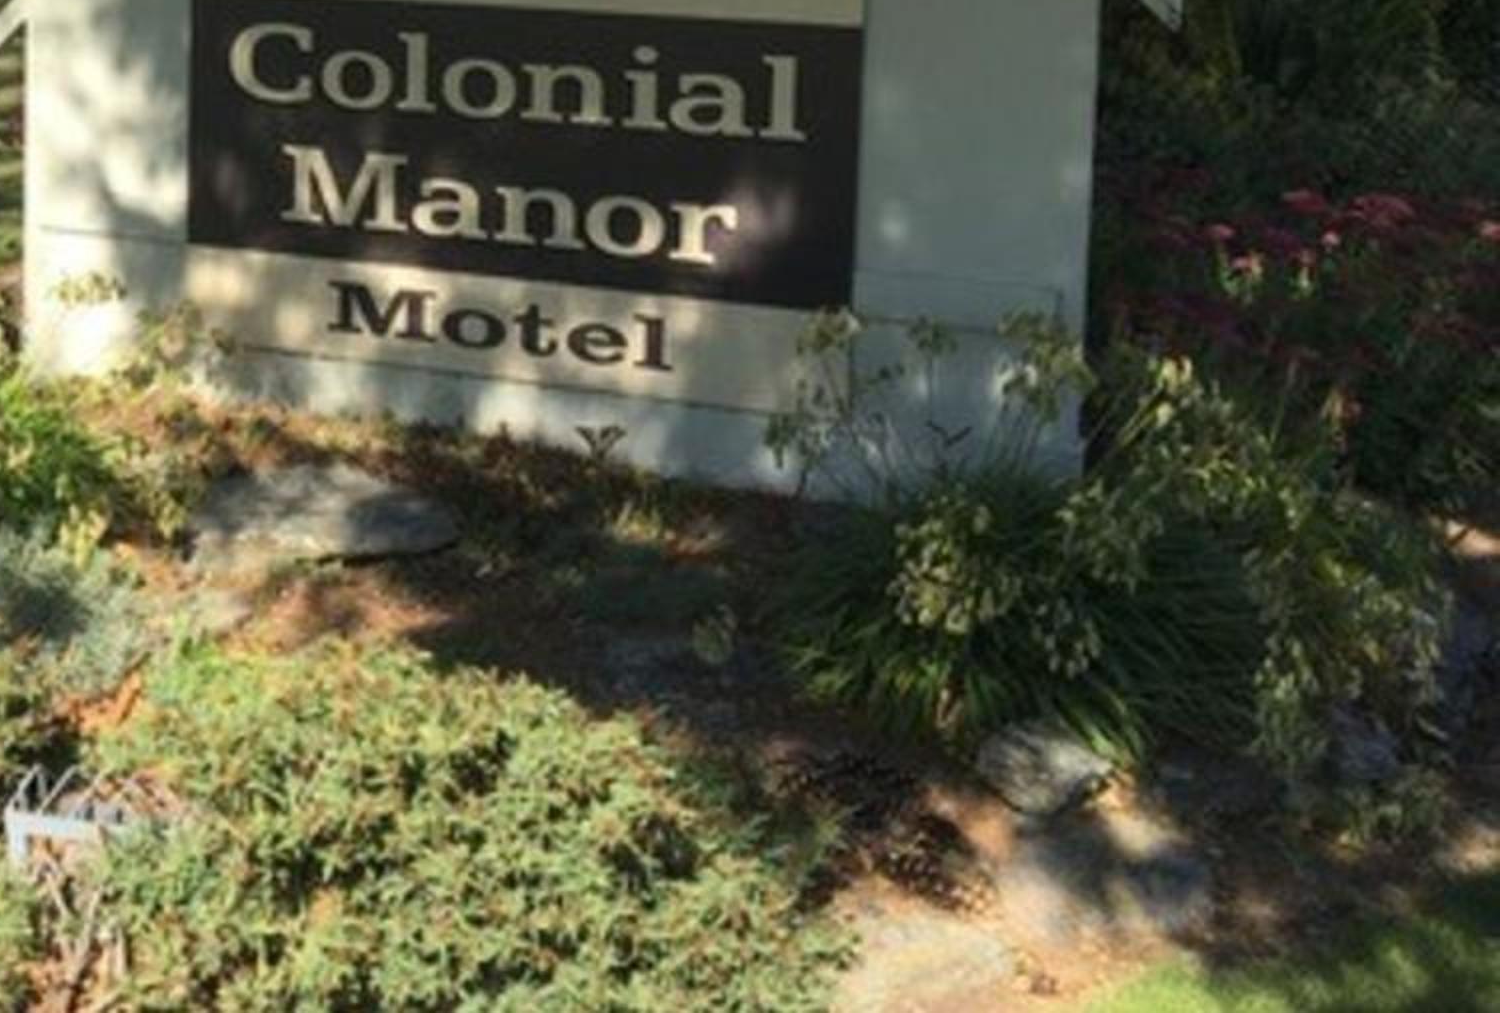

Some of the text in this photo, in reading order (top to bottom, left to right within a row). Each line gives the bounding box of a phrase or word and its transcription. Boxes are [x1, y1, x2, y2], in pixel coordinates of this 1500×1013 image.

[229, 22, 806, 141] Colonial
[280, 144, 737, 265] Manor
[327, 281, 674, 371] Motel
